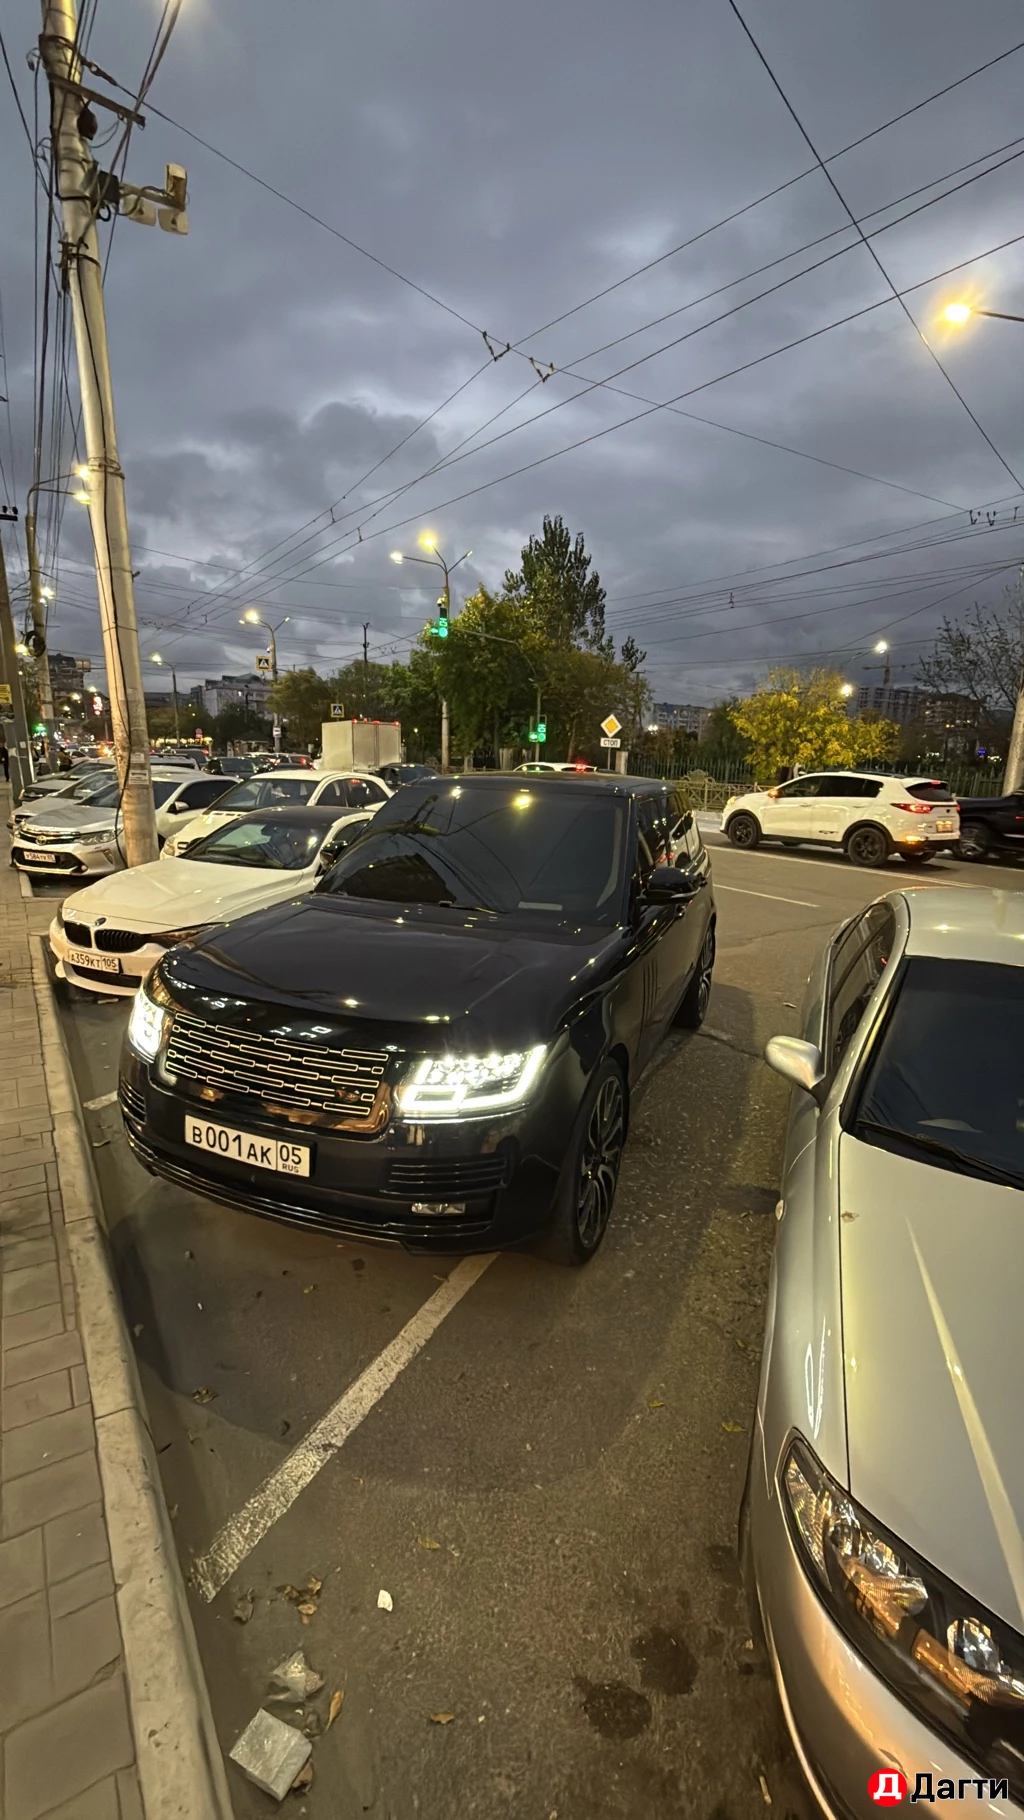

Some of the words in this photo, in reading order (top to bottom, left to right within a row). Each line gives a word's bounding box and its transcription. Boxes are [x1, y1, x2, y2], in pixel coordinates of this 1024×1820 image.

[603, 738, 619, 747] СТОП
[279, 1144, 302, 1165] 05
[281, 1163, 300, 1173] RUS
